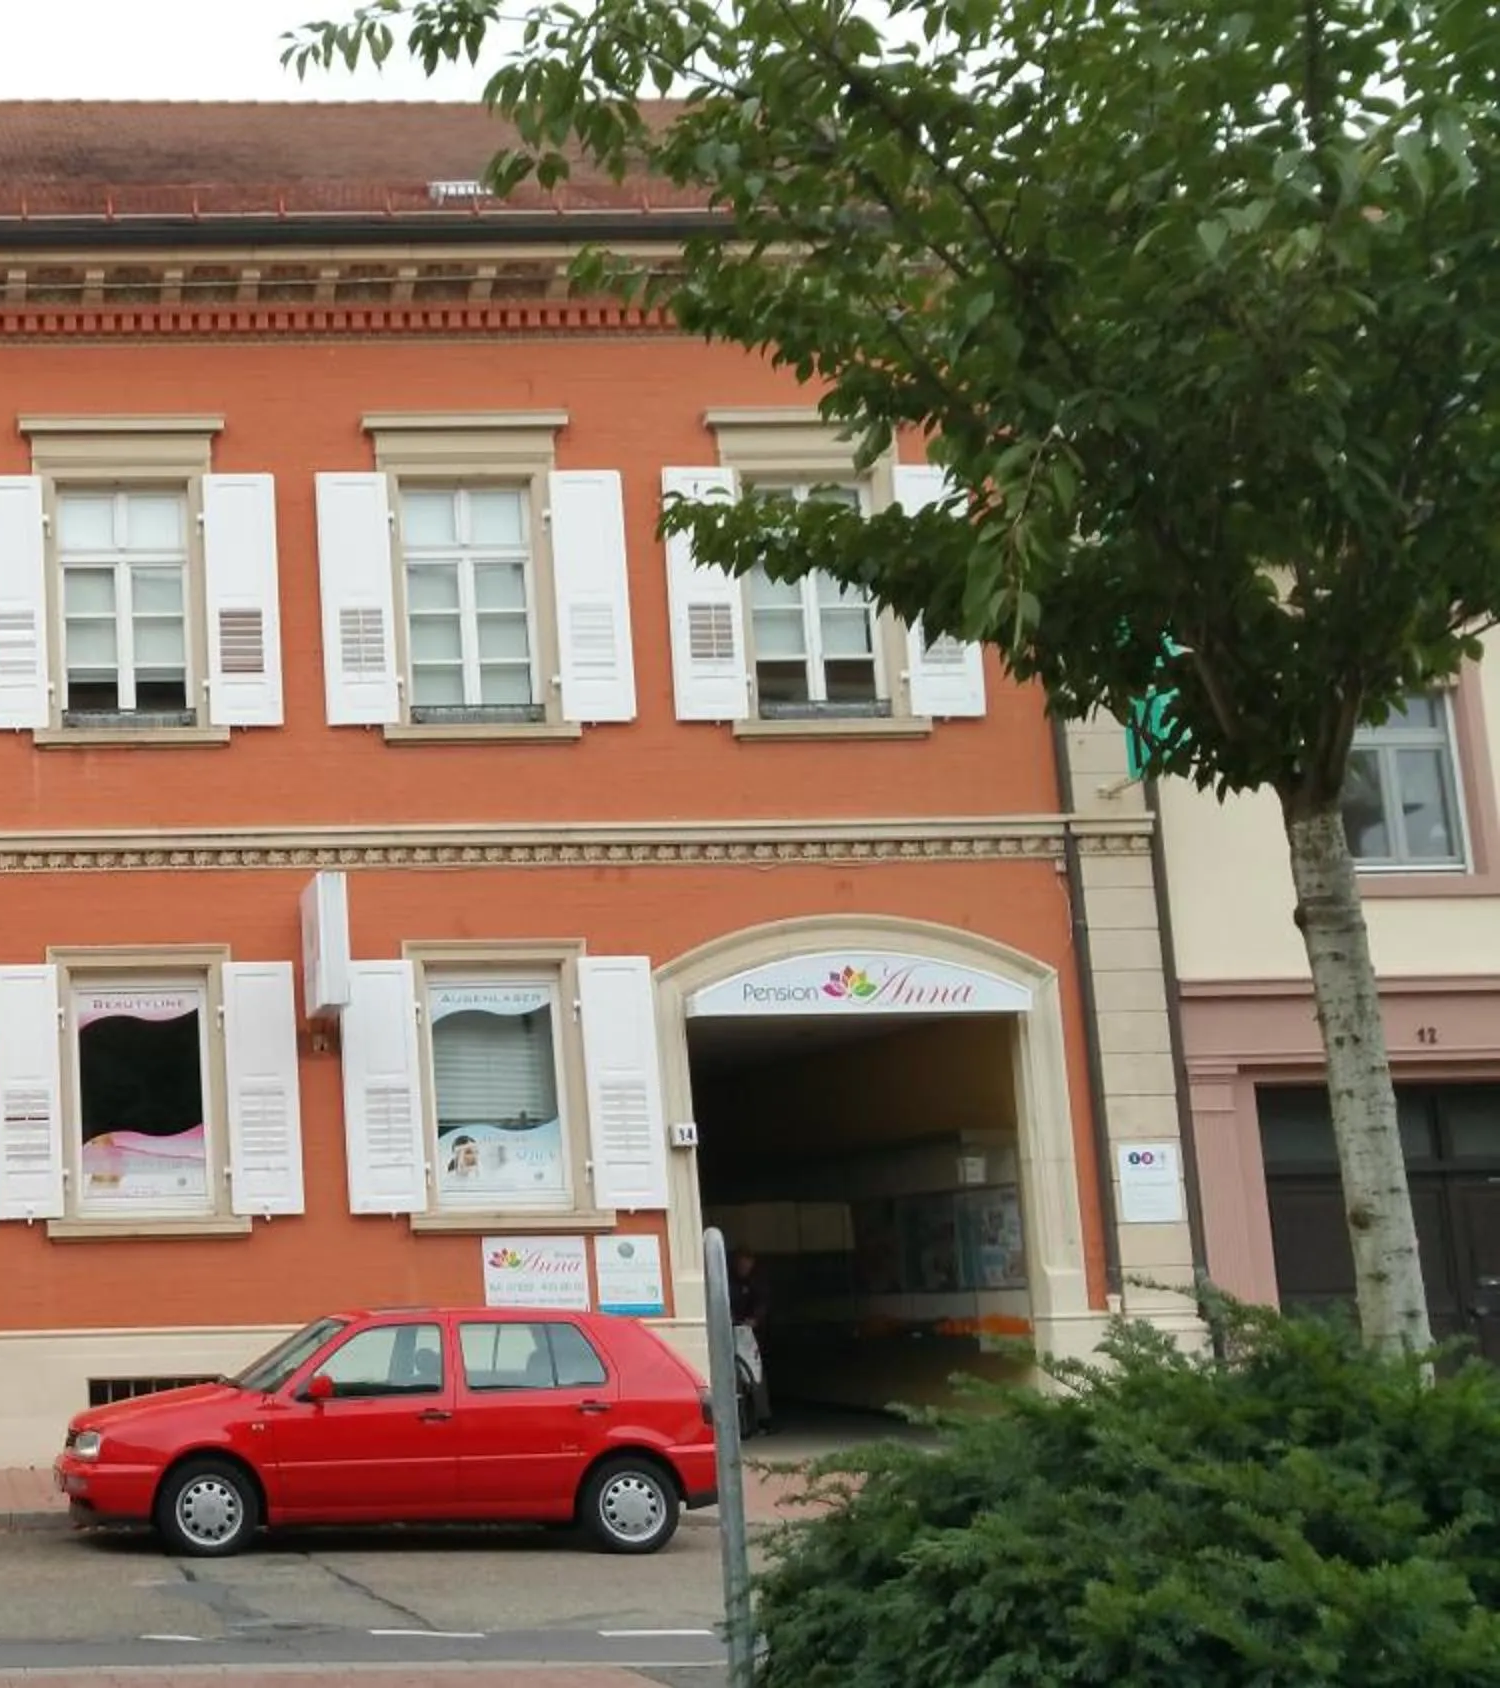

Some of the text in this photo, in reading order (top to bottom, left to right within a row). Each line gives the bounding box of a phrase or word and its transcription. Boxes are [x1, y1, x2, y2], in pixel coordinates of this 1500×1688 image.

[743, 960, 974, 1006] Pension Anna
[1417, 1026, 1438, 1045] 12
[678, 1127, 694, 1142] 14
